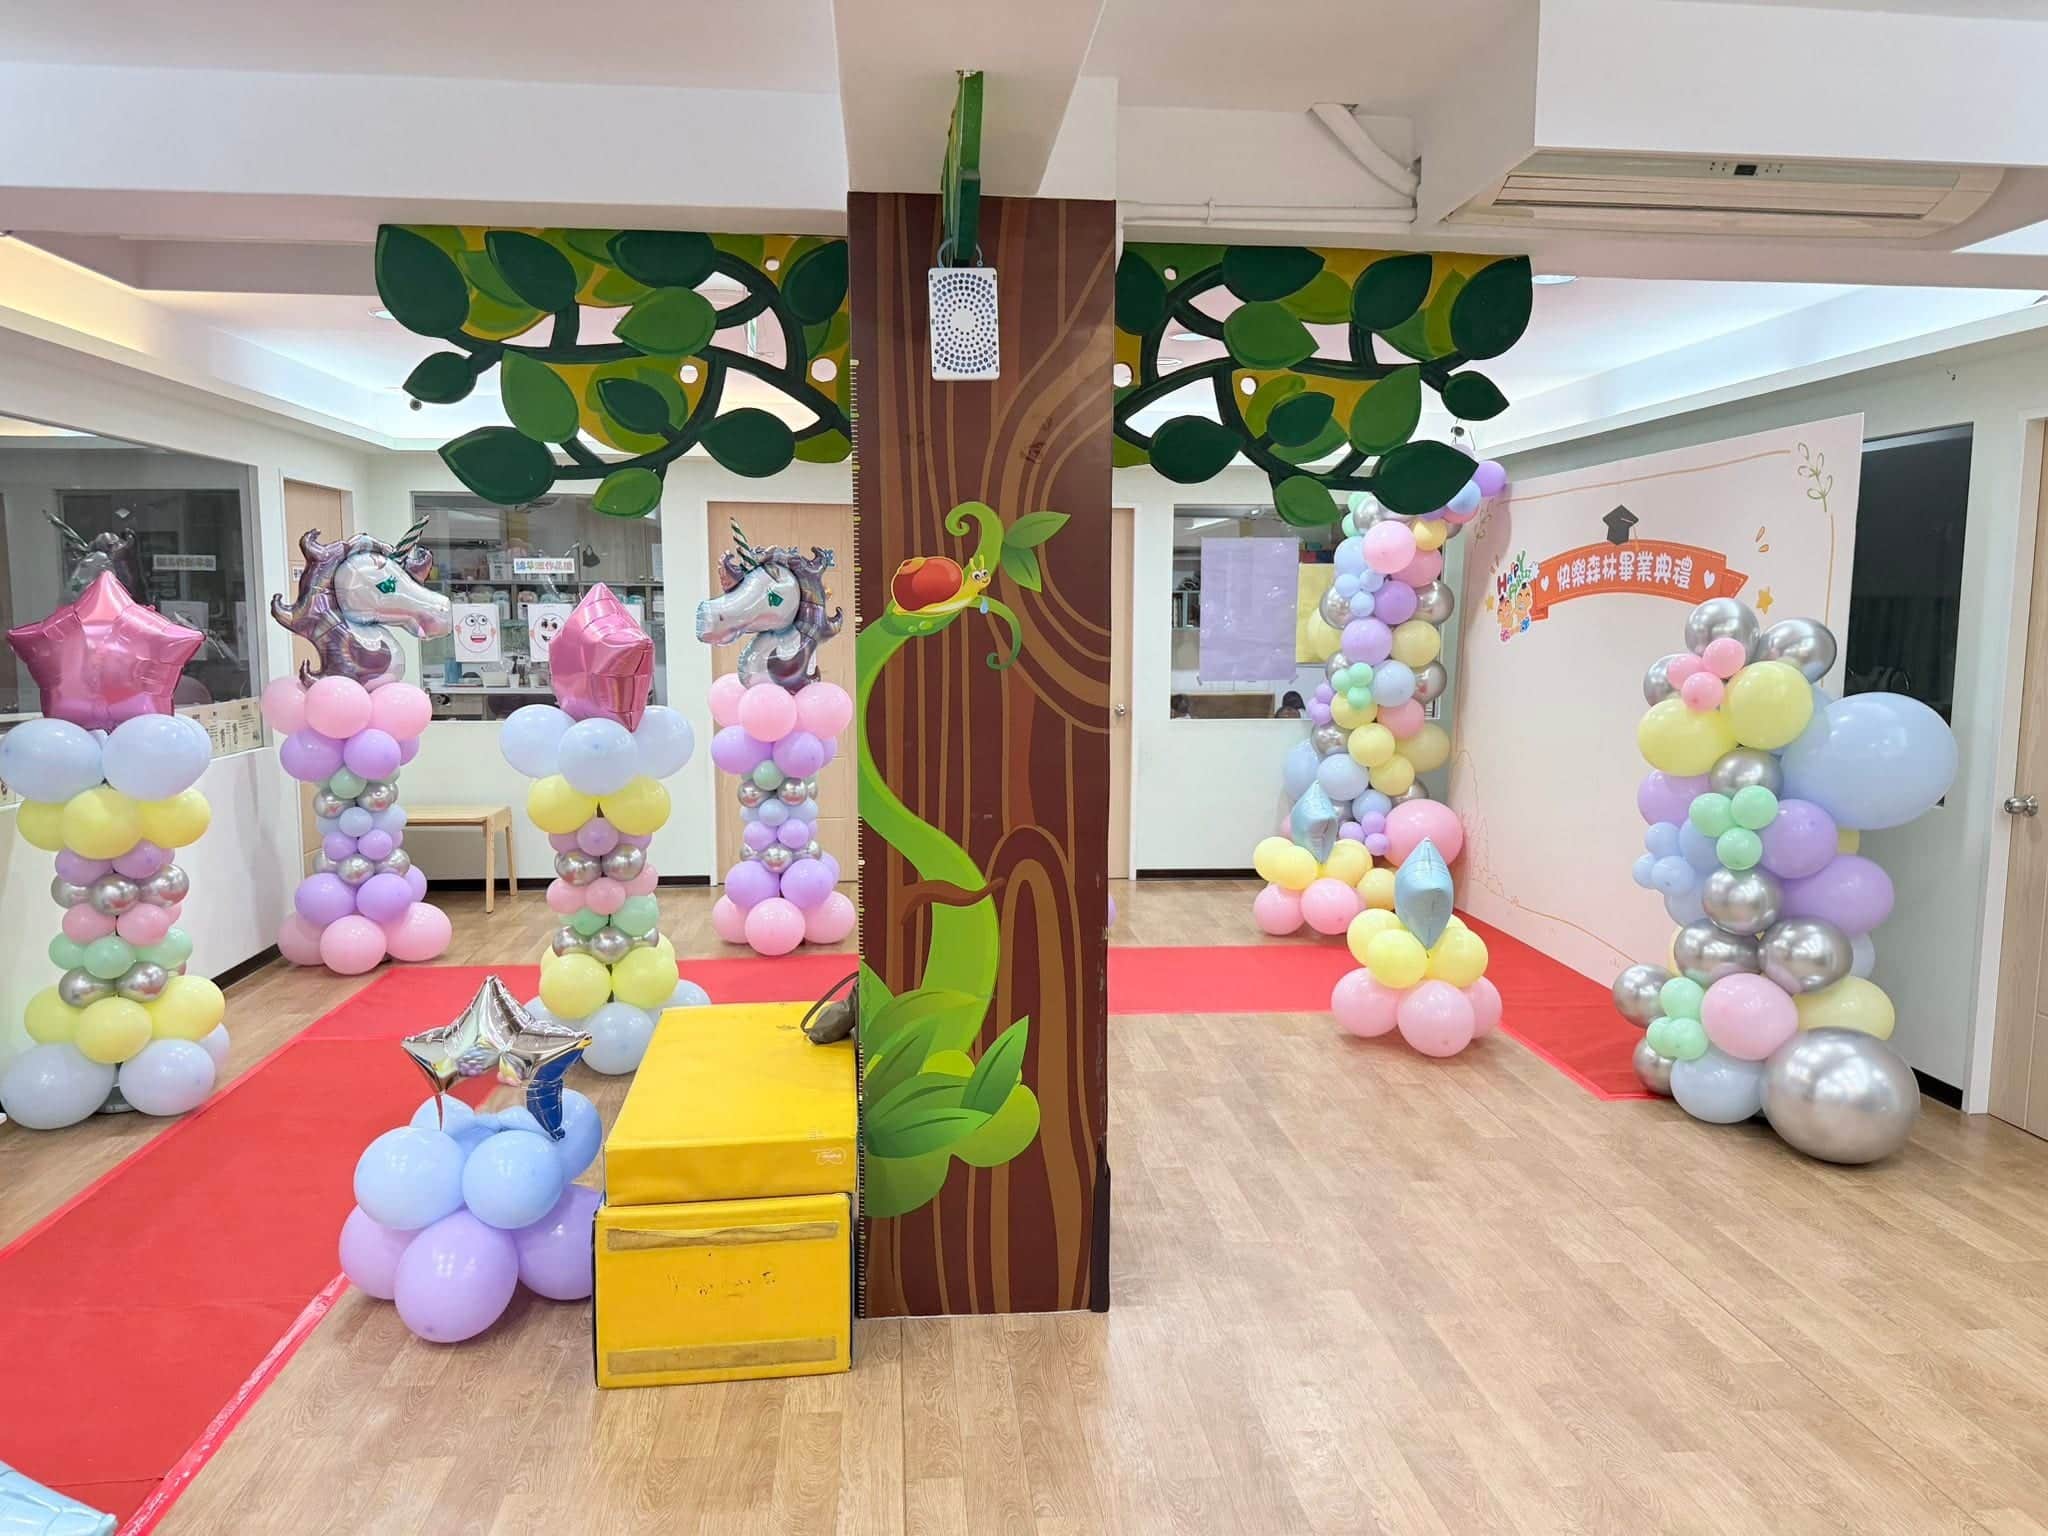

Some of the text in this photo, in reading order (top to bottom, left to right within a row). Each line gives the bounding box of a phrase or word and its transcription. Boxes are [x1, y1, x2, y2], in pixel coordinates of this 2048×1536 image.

[1557, 550, 1693, 592] 快樂森林畢業典禮
